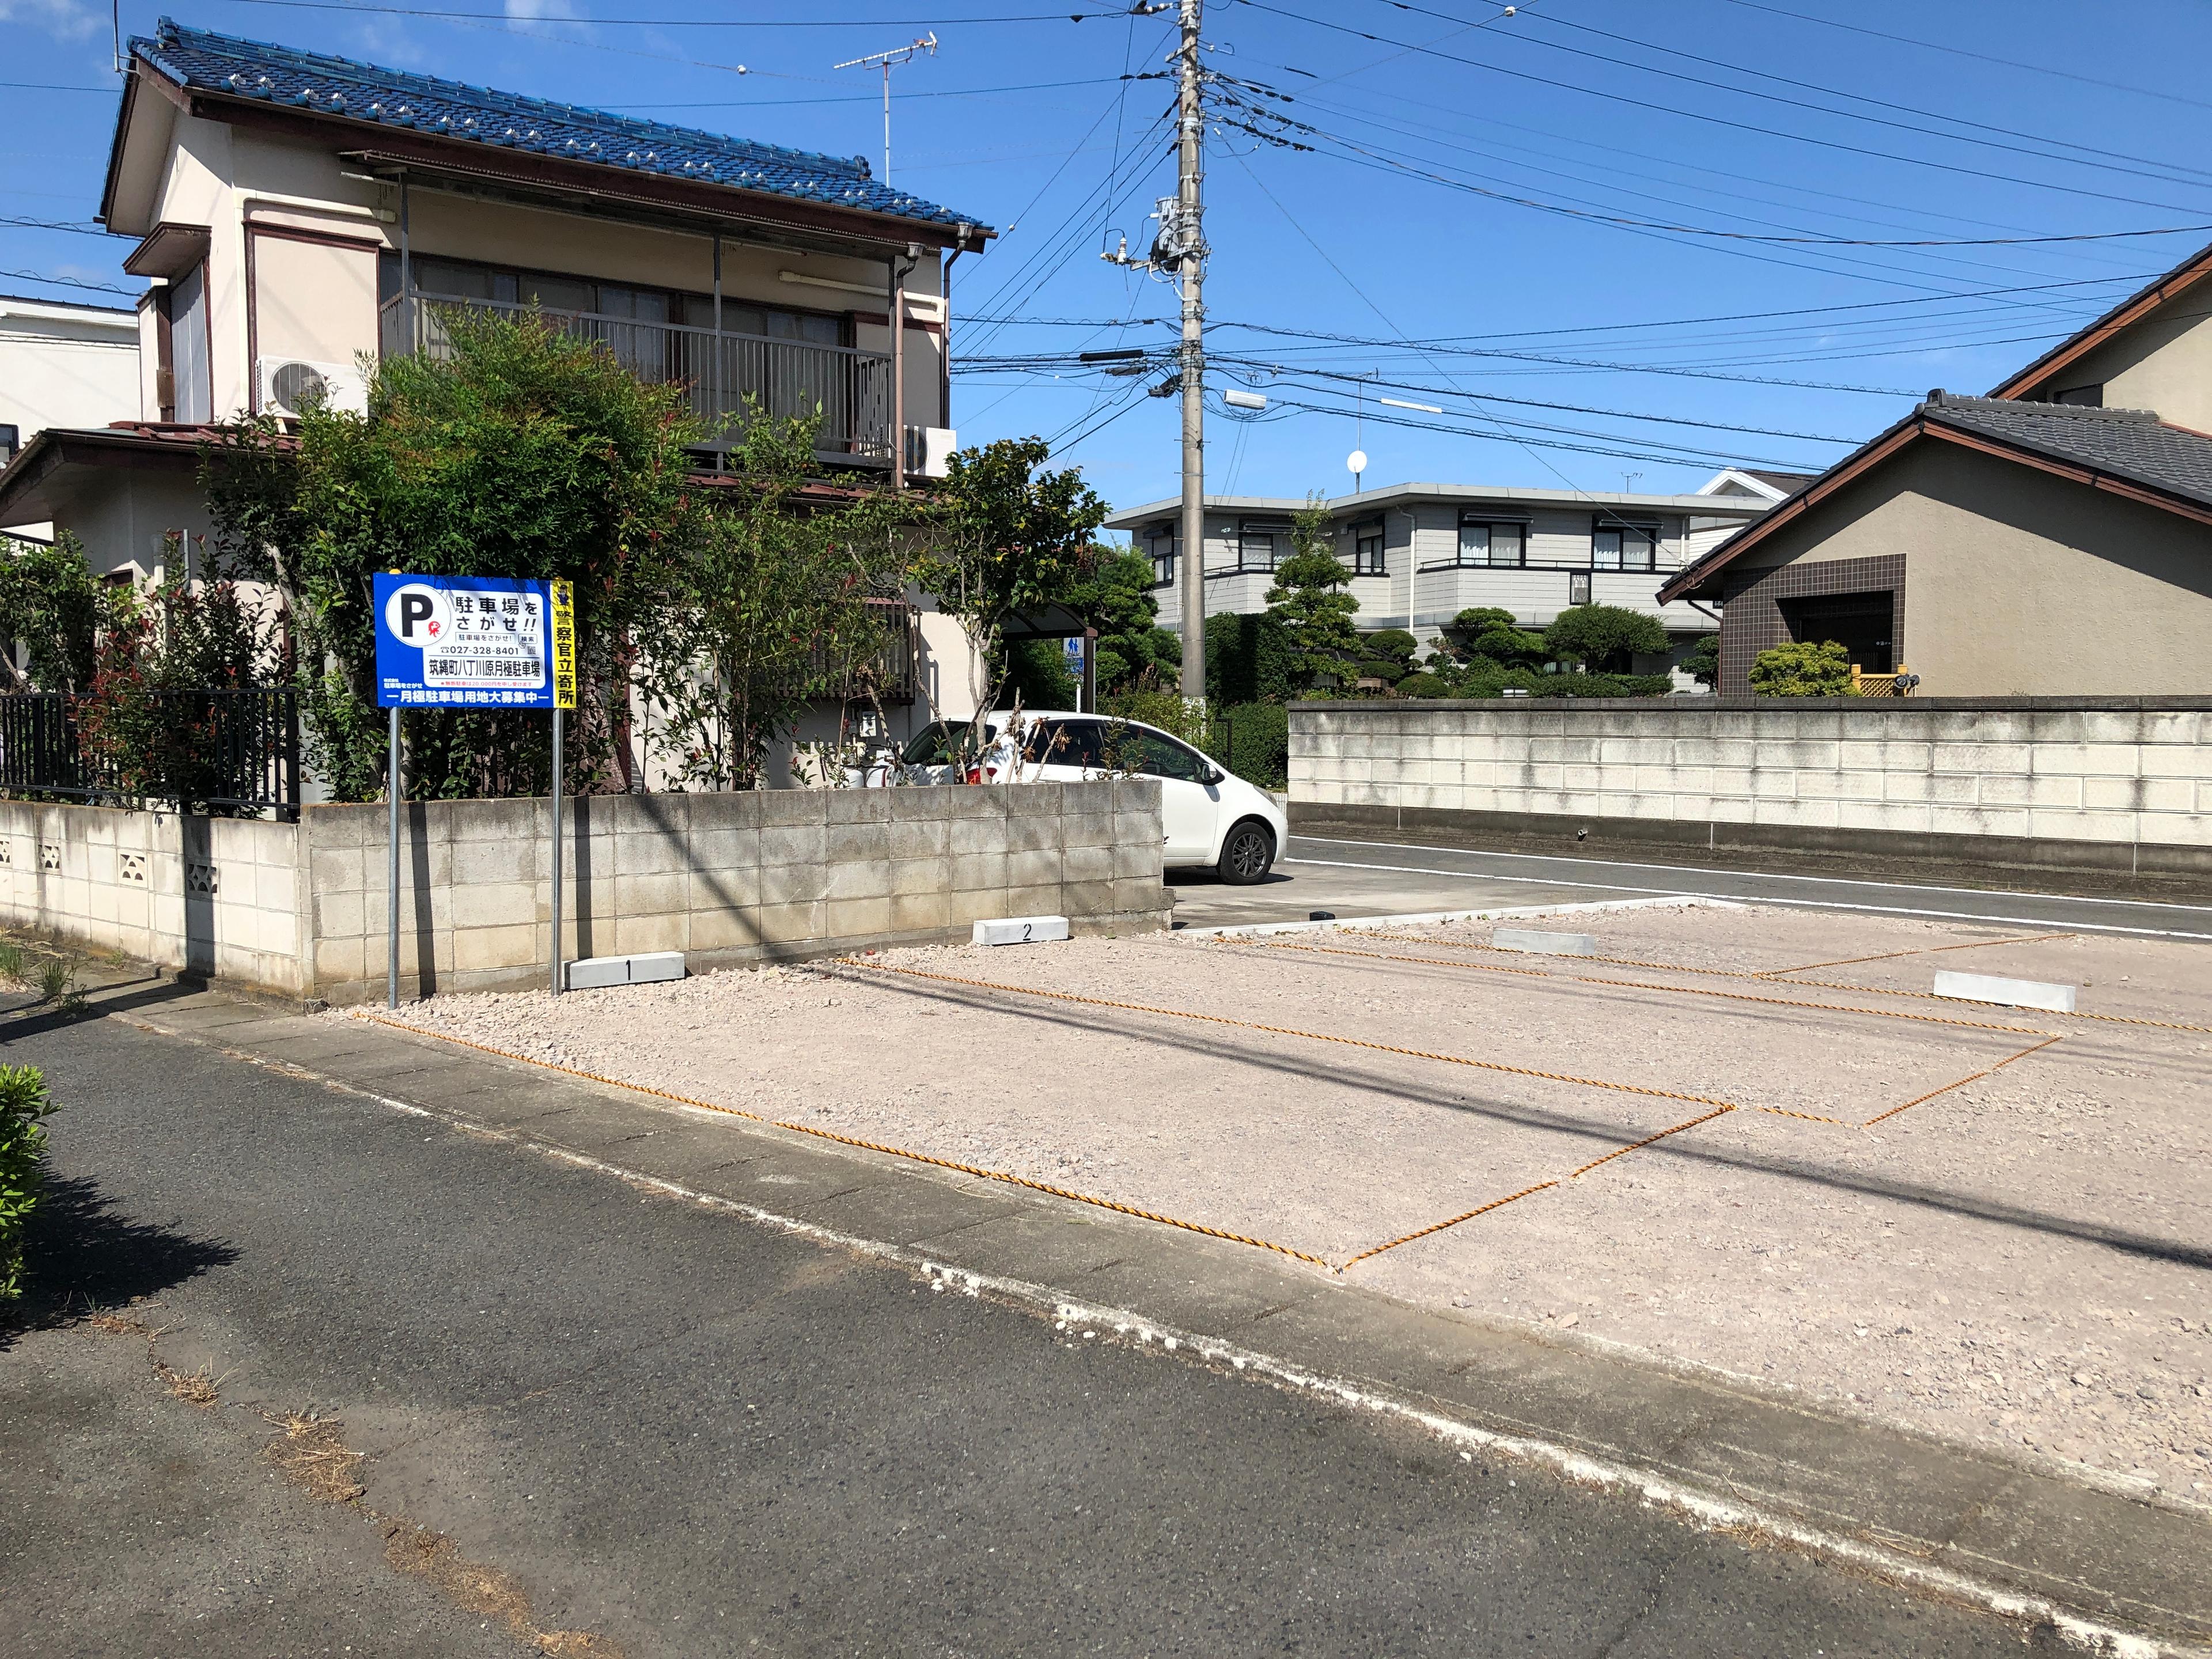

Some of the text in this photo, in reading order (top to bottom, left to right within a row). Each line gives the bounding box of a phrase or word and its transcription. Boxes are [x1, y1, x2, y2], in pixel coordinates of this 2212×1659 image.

[401, 593, 434, 637] P
[456, 596, 537, 615] 駐車場を
[450, 646, 518, 655] 027-328-8401
[556, 611, 574, 705] 警察官立寄所
[429, 659, 540, 677] 筑縄町八丁川原月極駐車場
[1022, 923, 1032, 941] 2
[626, 959, 631, 981] 1
